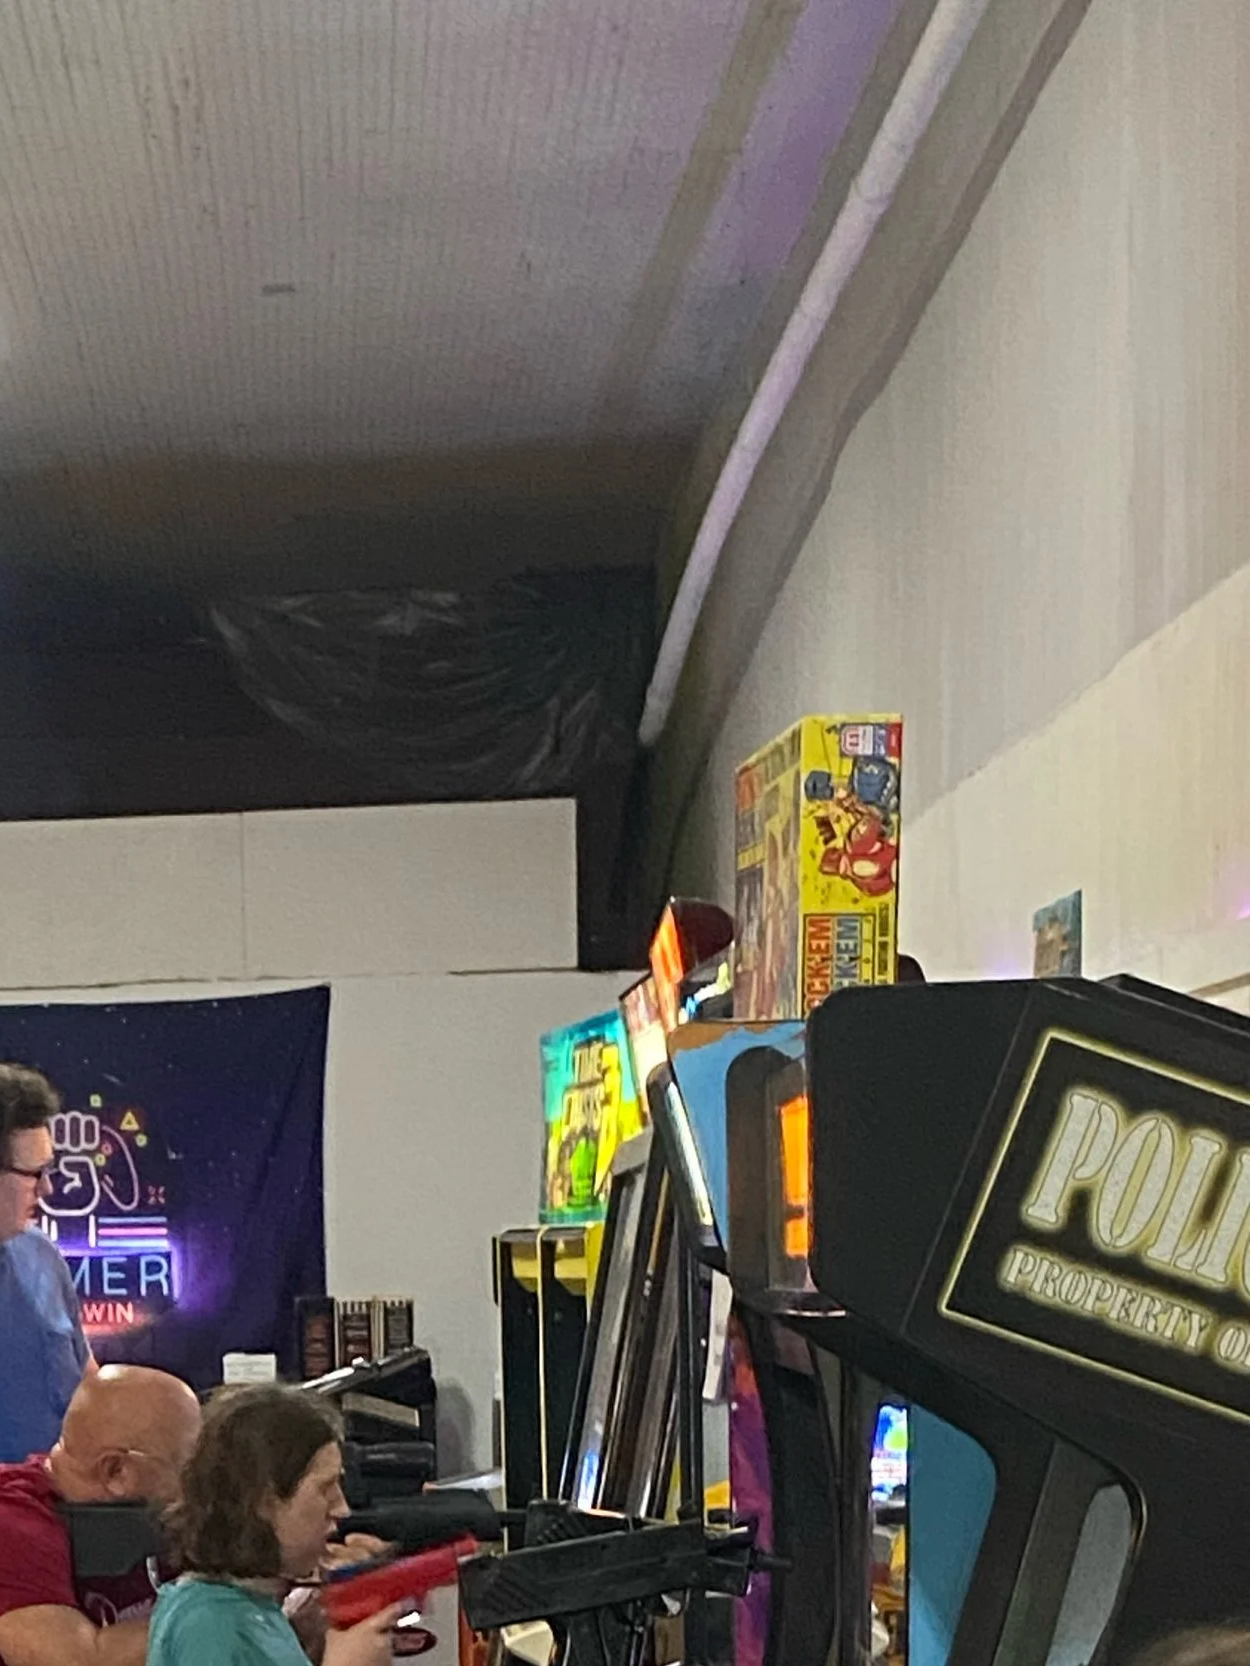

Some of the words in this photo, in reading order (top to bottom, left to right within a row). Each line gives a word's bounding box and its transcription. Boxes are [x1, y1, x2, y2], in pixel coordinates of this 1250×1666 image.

[1026, 1092, 1250, 1286] POLI
[83, 1301, 134, 1324] WIN
[1005, 1248, 1208, 1348] PROPERTY
